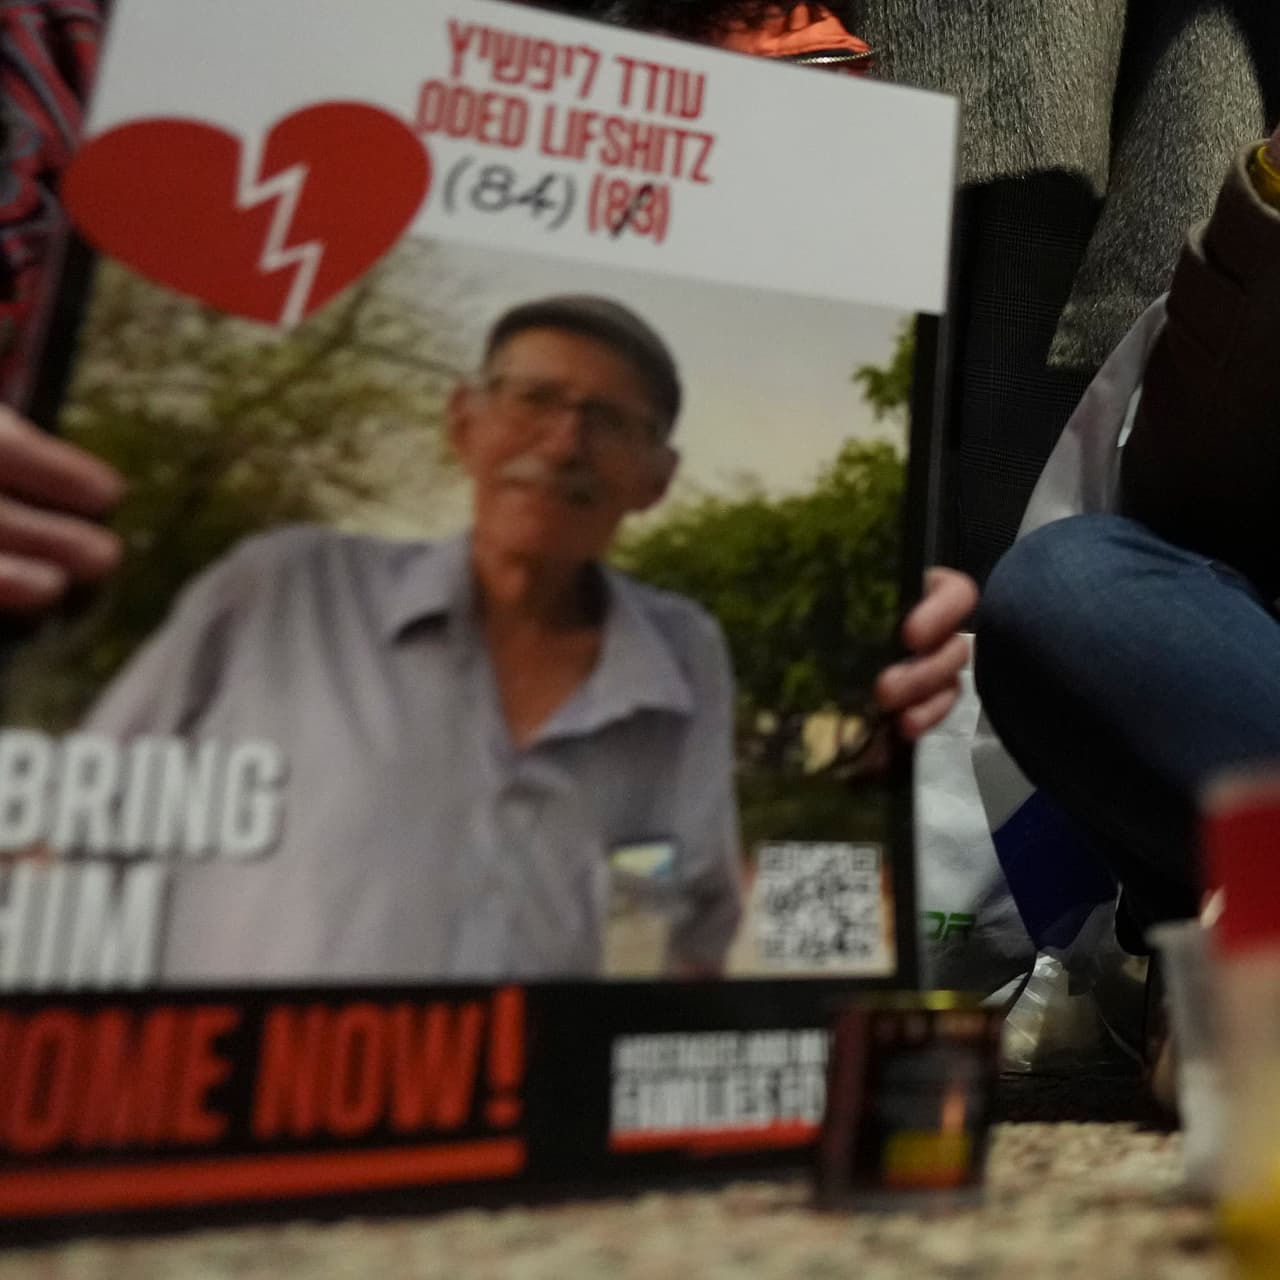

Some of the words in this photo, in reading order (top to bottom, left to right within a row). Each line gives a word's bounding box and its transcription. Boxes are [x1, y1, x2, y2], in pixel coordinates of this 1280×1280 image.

[447, 17, 602, 100] ליפשיץ
[614, 54, 708, 120] עודד
[416, 80, 531, 149] ODED
[540, 102, 716, 184] LIFSHITZ
[442, 156, 577, 230] (84)
[0, 728, 288, 858] BRING
[251, 984, 527, 1140] NOW!
